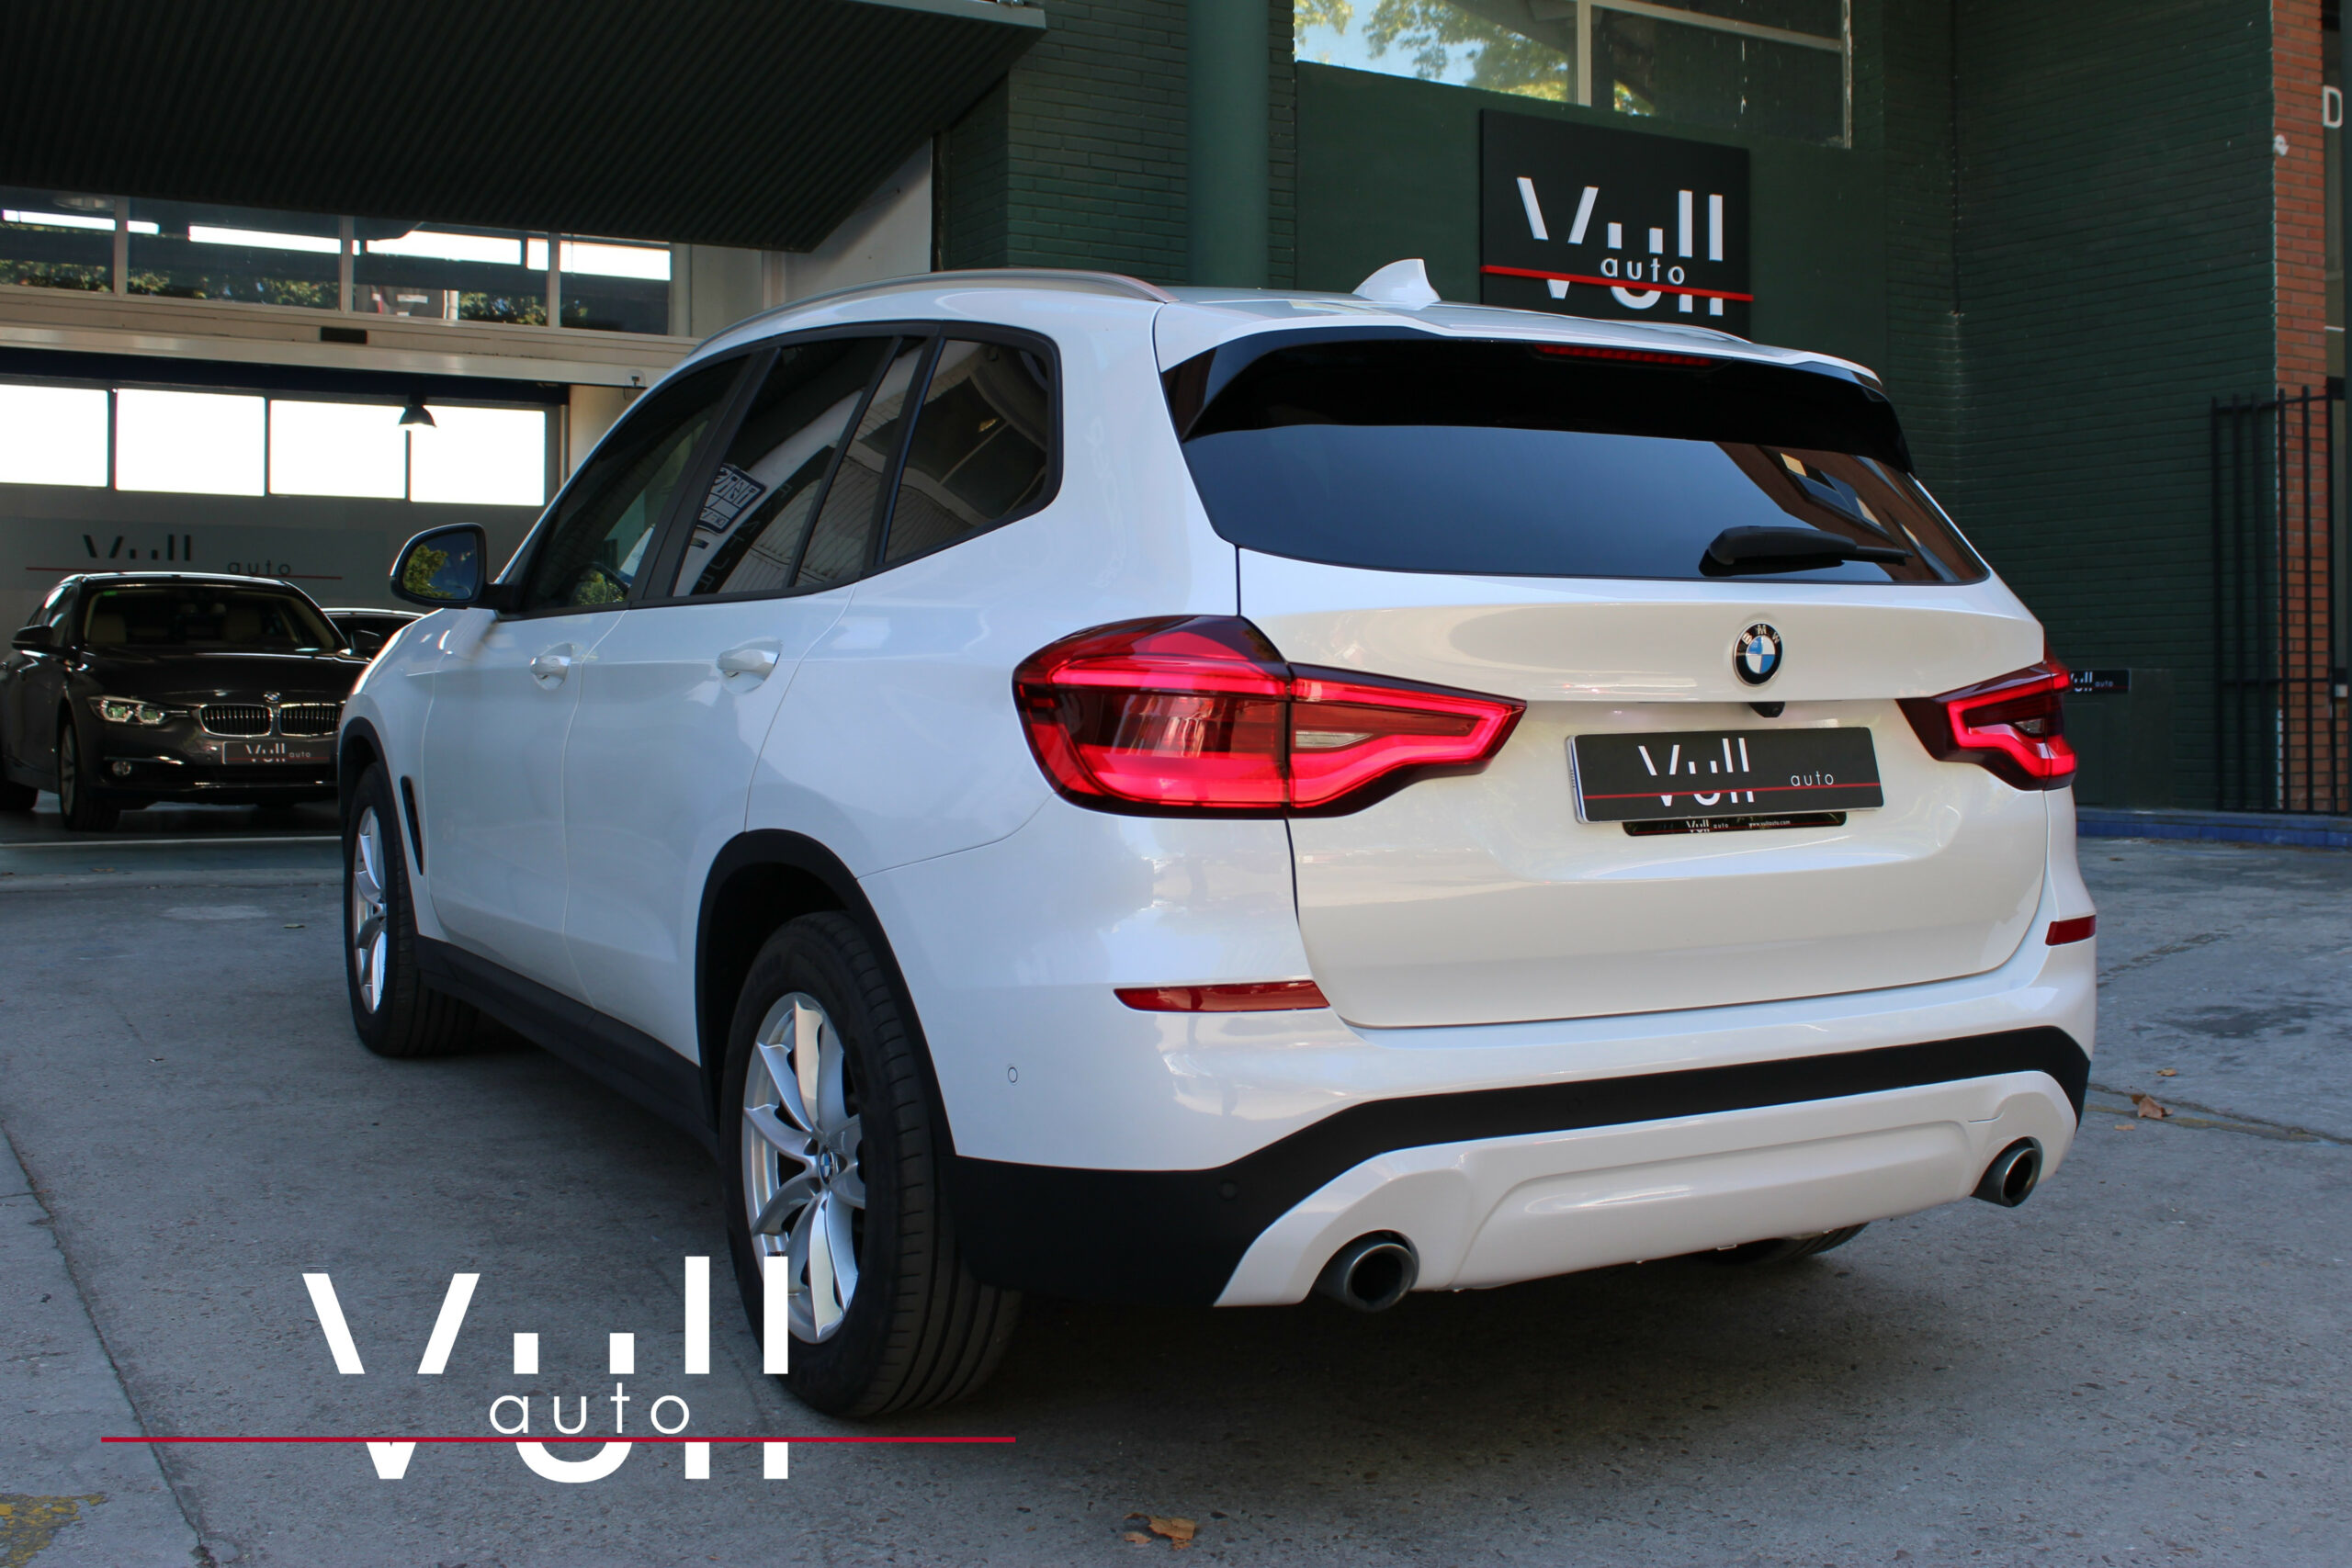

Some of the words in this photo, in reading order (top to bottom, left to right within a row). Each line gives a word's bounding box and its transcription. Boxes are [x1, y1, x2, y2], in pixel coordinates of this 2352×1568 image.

[1600, 257, 1685, 286] auto
[228, 559, 291, 575] auto
[1741, 625, 1781, 645] BMW
[1791, 770, 1835, 786] auto
